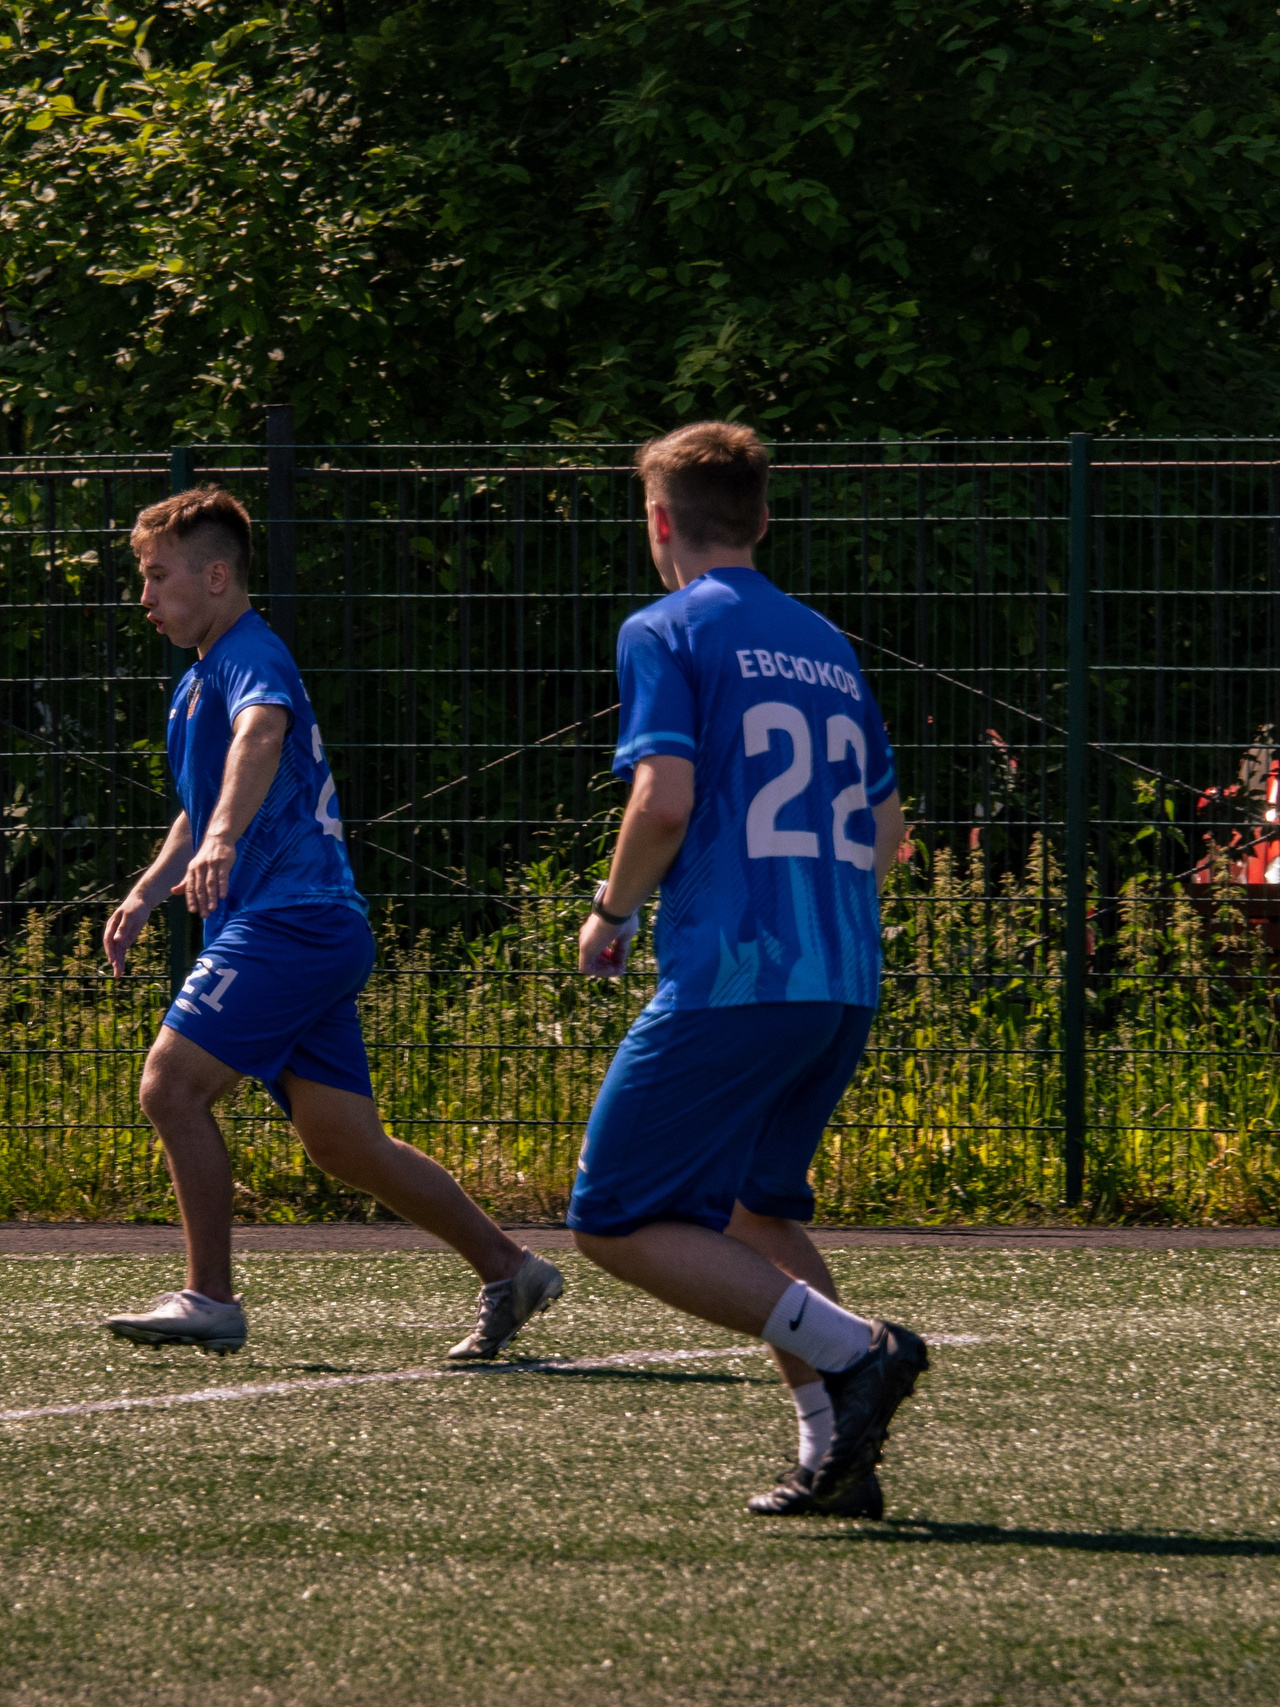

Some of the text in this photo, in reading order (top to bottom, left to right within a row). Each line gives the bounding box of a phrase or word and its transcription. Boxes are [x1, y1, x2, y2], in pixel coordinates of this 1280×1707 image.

[736, 649, 860, 701] ЕВСЮКОВ
[743, 702, 874, 871] 22
[182, 957, 239, 1012] 21
